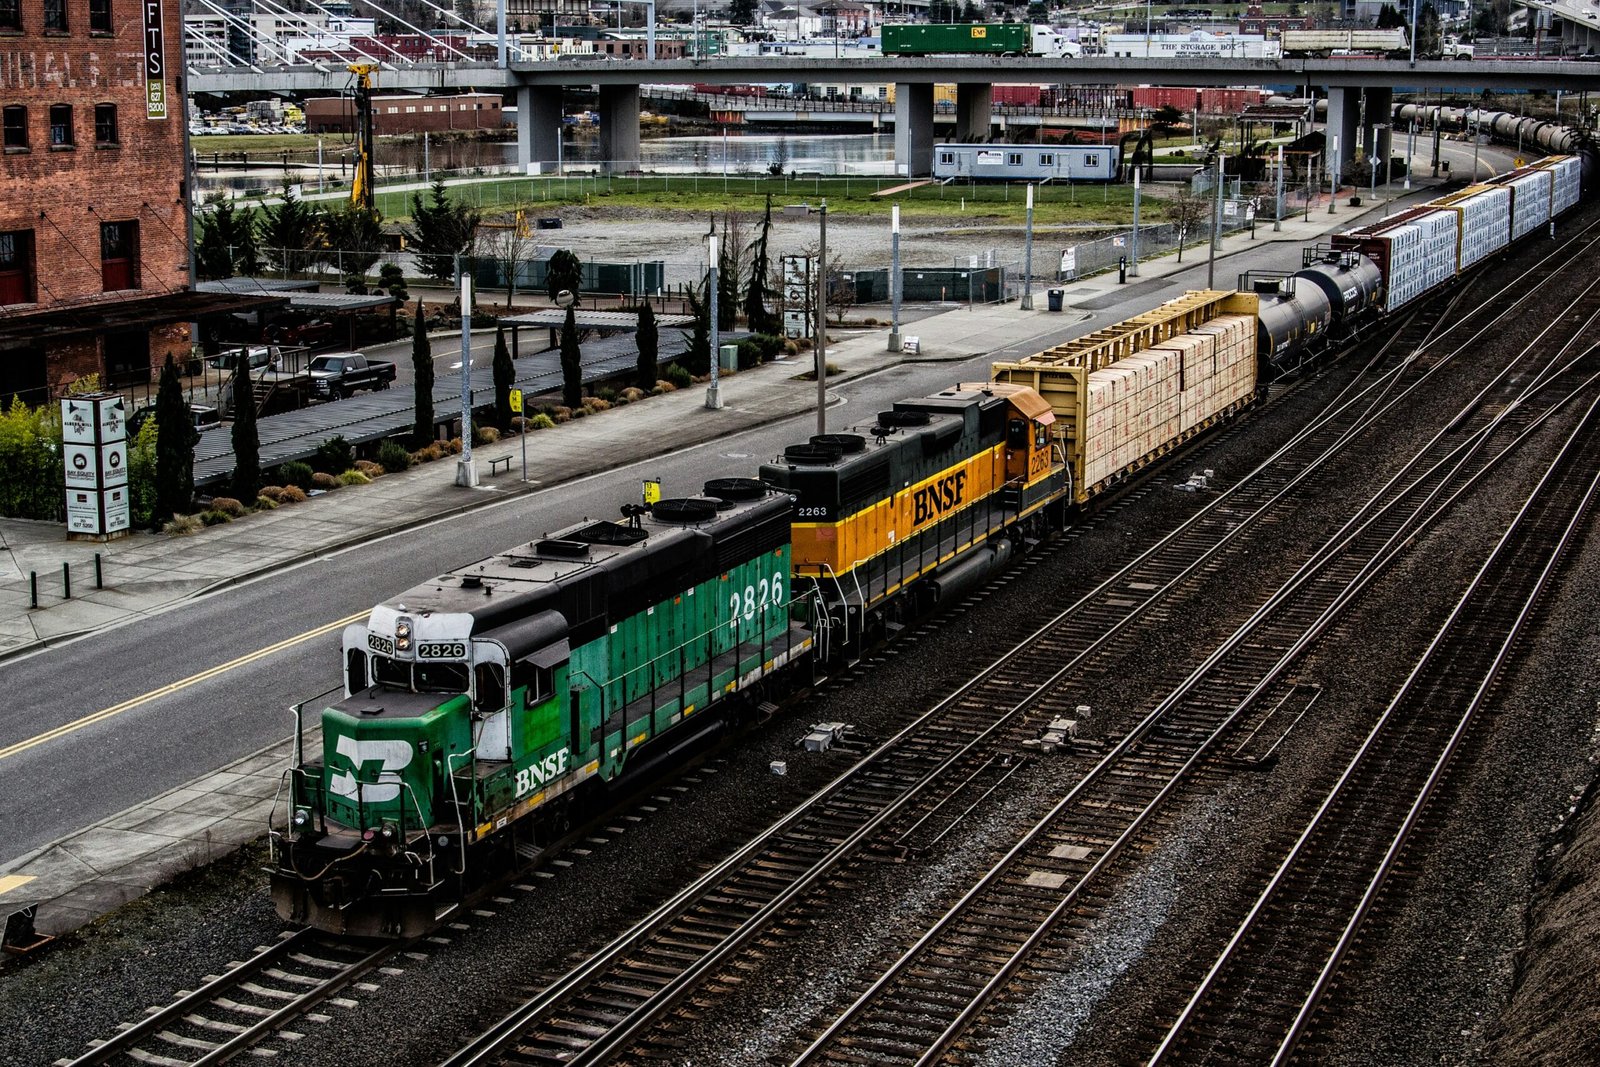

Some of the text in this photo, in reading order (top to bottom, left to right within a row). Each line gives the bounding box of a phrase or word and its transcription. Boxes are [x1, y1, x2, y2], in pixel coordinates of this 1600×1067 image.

[150, 92, 161, 101] 627
[149, 103, 164, 112] 5200
[913, 469, 967, 526] BNSF
[798, 507, 827, 517] 2263
[730, 571, 783, 629] 2826
[368, 635, 394, 654] 2826
[420, 644, 464, 657] 2826
[514, 746, 570, 799] BNSF
